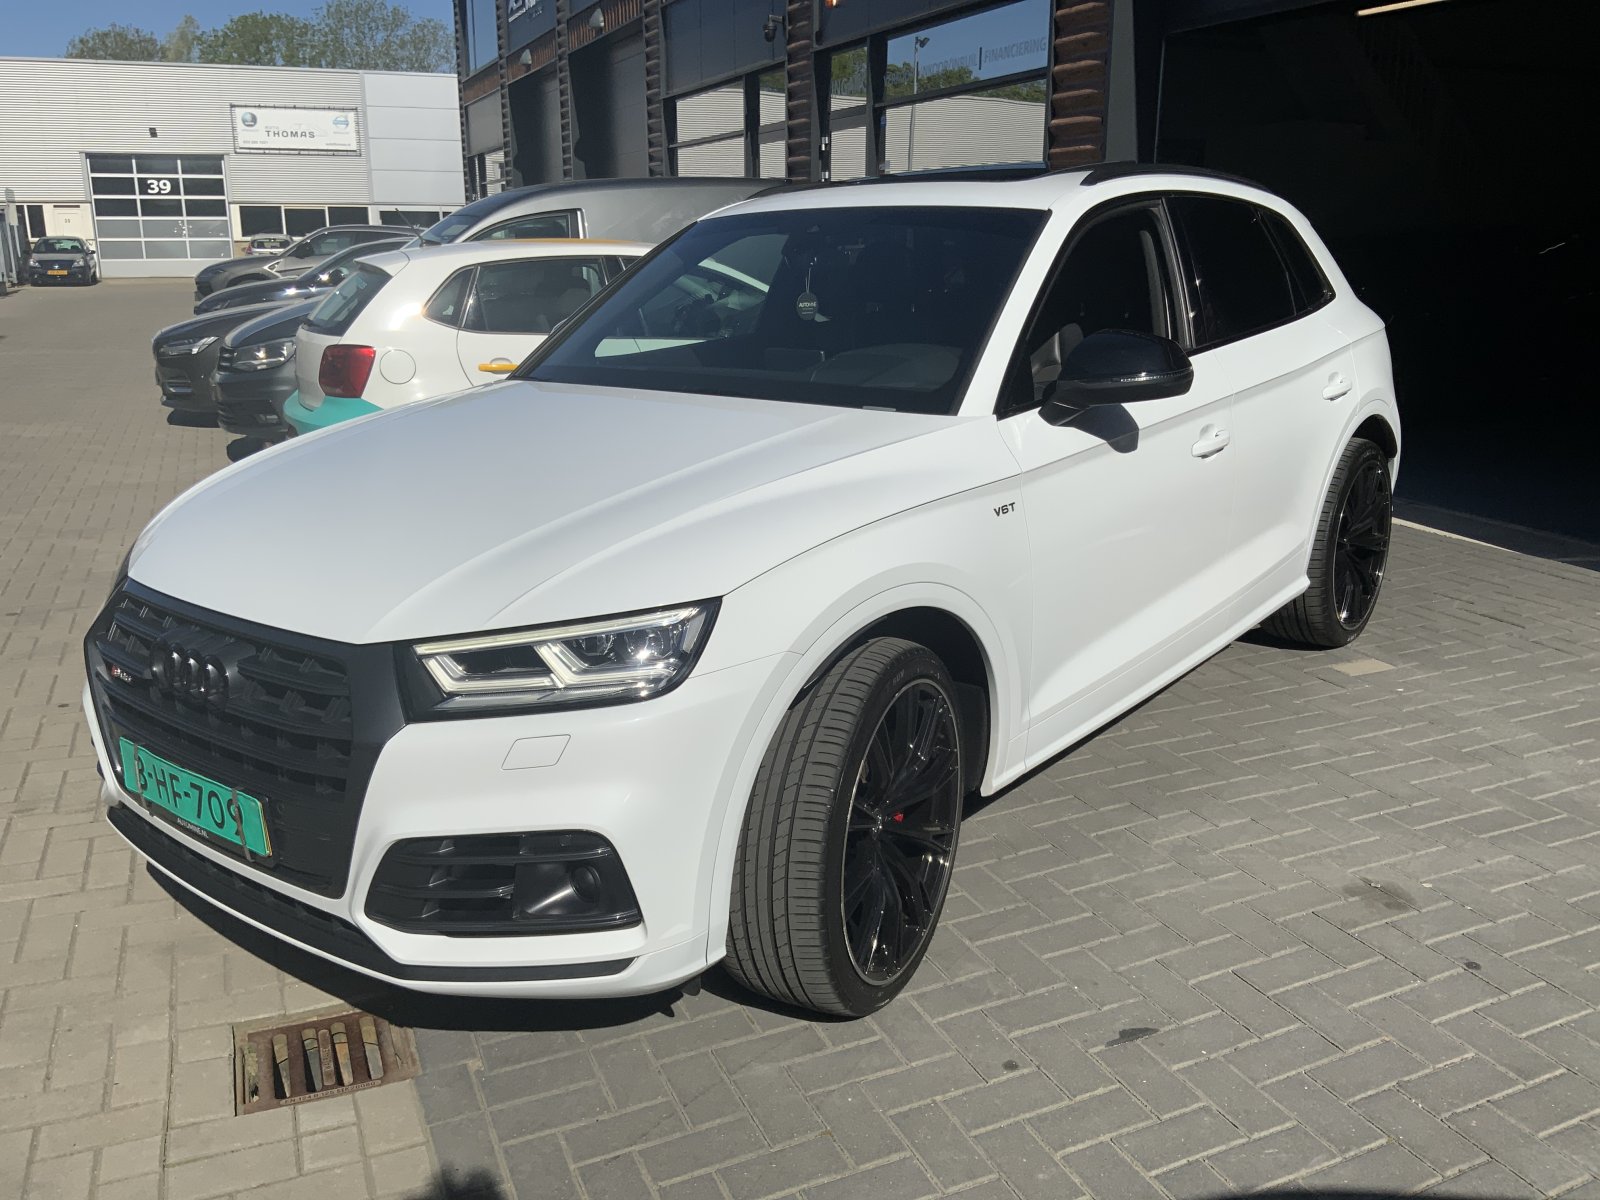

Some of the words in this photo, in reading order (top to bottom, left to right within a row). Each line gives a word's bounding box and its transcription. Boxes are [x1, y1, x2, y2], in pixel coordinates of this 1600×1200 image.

[984, 37, 1046, 63] FINANCIERING
[265, 130, 316, 139] THOMAS
[147, 179, 171, 194] 39
[993, 501, 1015, 517] V6T
[137, 754, 245, 836] B-HF-709
